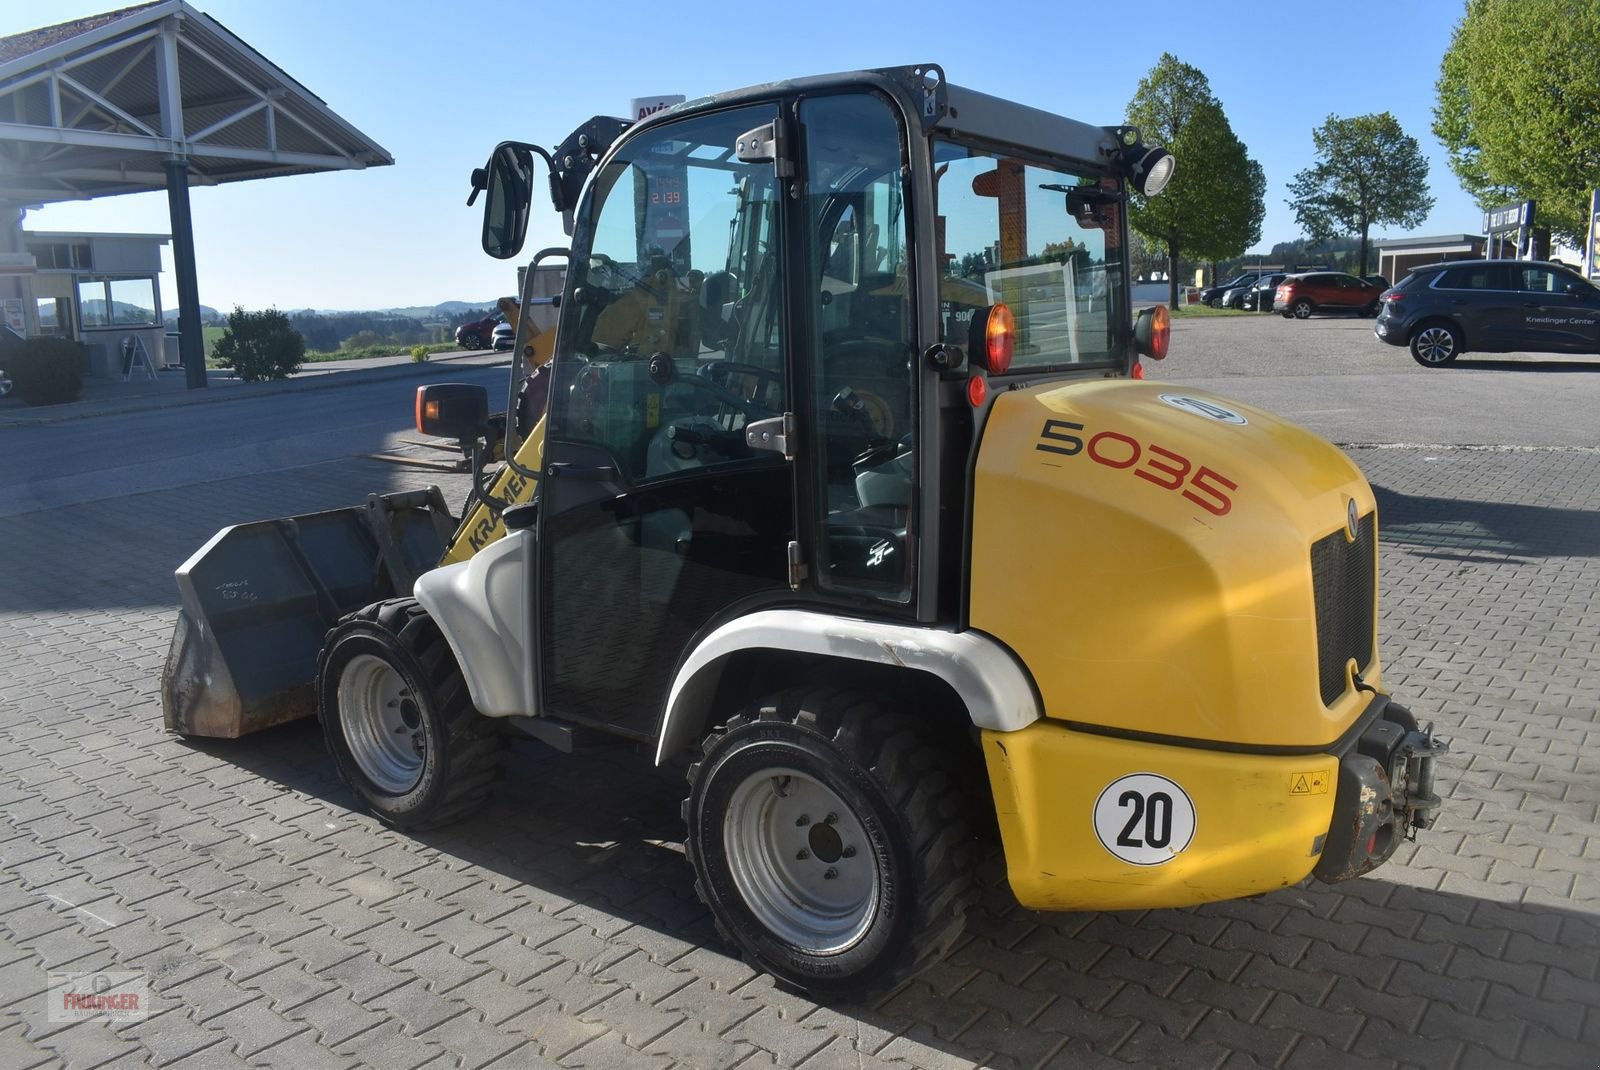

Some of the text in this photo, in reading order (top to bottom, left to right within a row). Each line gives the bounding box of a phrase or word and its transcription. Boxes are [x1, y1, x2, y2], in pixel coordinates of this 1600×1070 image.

[1569, 317, 1596, 325] Center
[1036, 419, 1238, 516] 5035
[1116, 790, 1173, 849] 20
